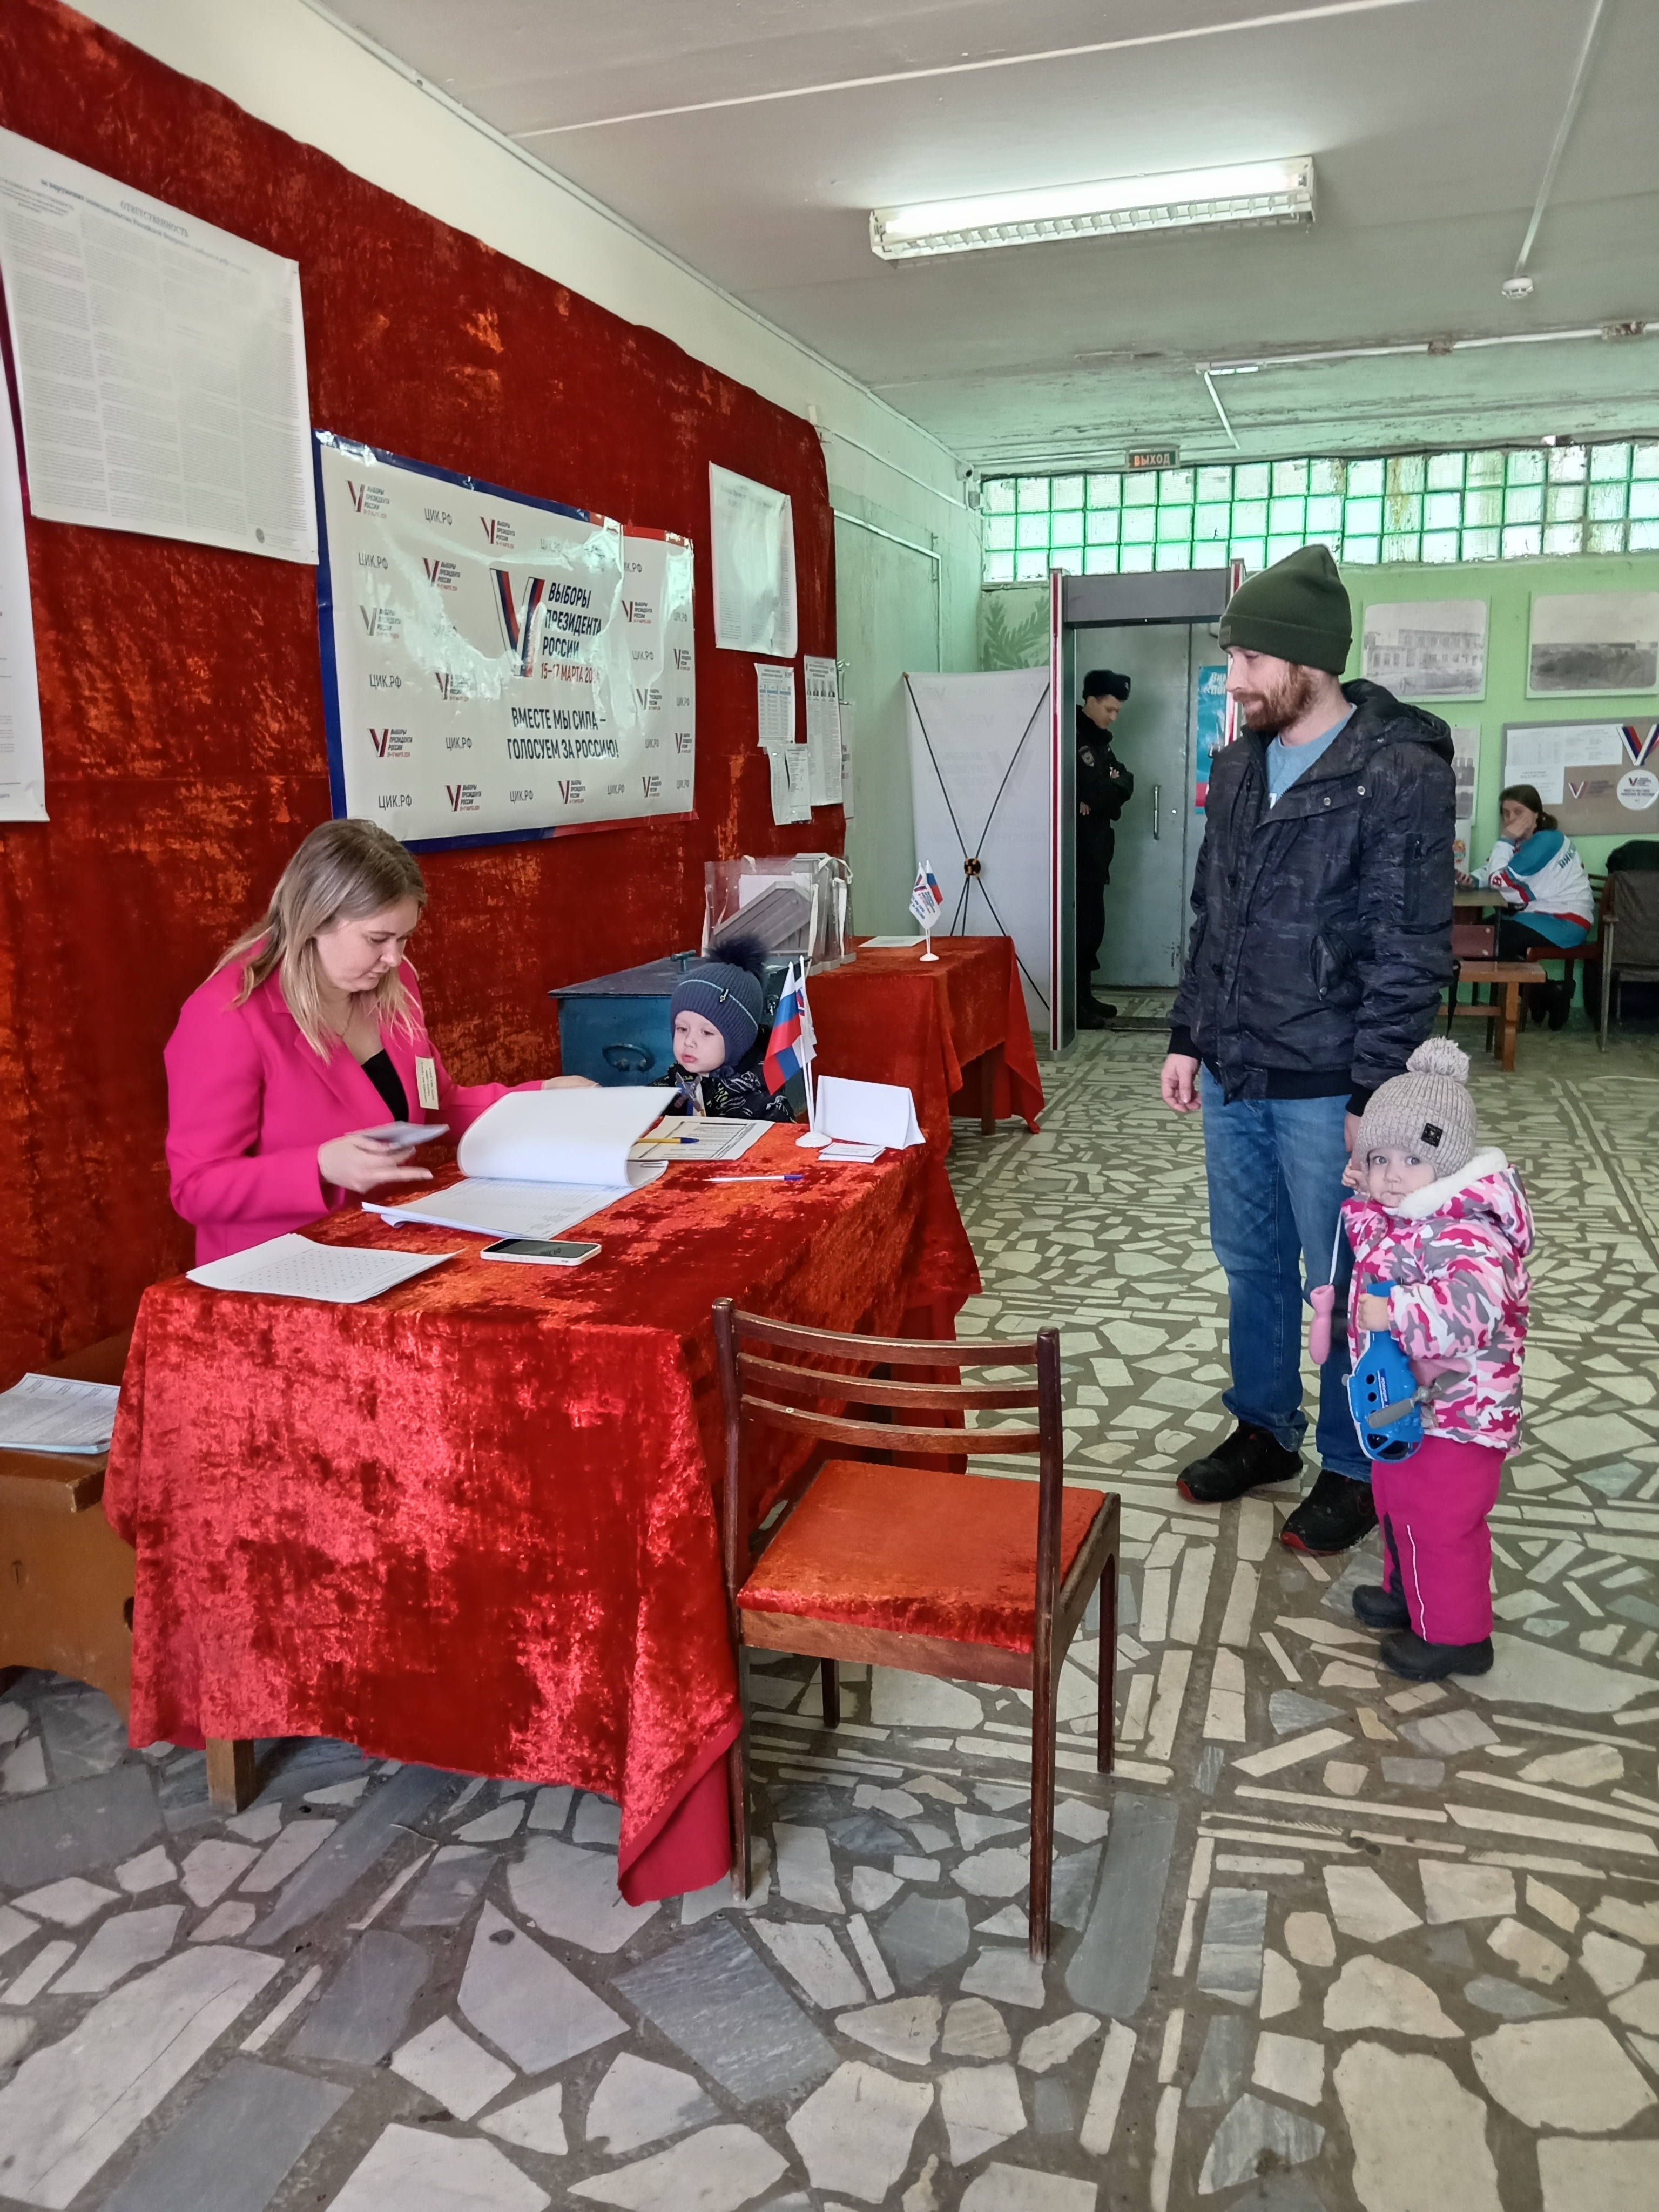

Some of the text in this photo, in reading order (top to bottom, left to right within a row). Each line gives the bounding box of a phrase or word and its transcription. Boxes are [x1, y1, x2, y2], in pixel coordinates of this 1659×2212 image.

[1134, 453, 1170, 467] ВЫХОД
[424, 508, 453, 525] ЦИК.РФ
[359, 552, 388, 570] ЦИК.РФ
[548, 582, 591, 608] ВЫБОРЫ
[544, 609, 602, 637] ПРЕЗИДЕНТА
[542, 636, 579, 658] РОССИИ
[369, 674, 402, 690] ЦИК.РФ
[561, 664, 583, 682] МАРТА
[511, 707, 551, 729] ВМЕСТЕ
[553, 709, 571, 730] МЫ
[572, 710, 598, 730] СИЛА
[446, 737, 473, 751] ЦИК.РФ
[507, 738, 619, 759] ГОЛОСУЕМ ЗА РОССИЮ!
[378, 794, 412, 811] ЦИК.РФ
[510, 790, 533, 804] ЦИК.РФ
